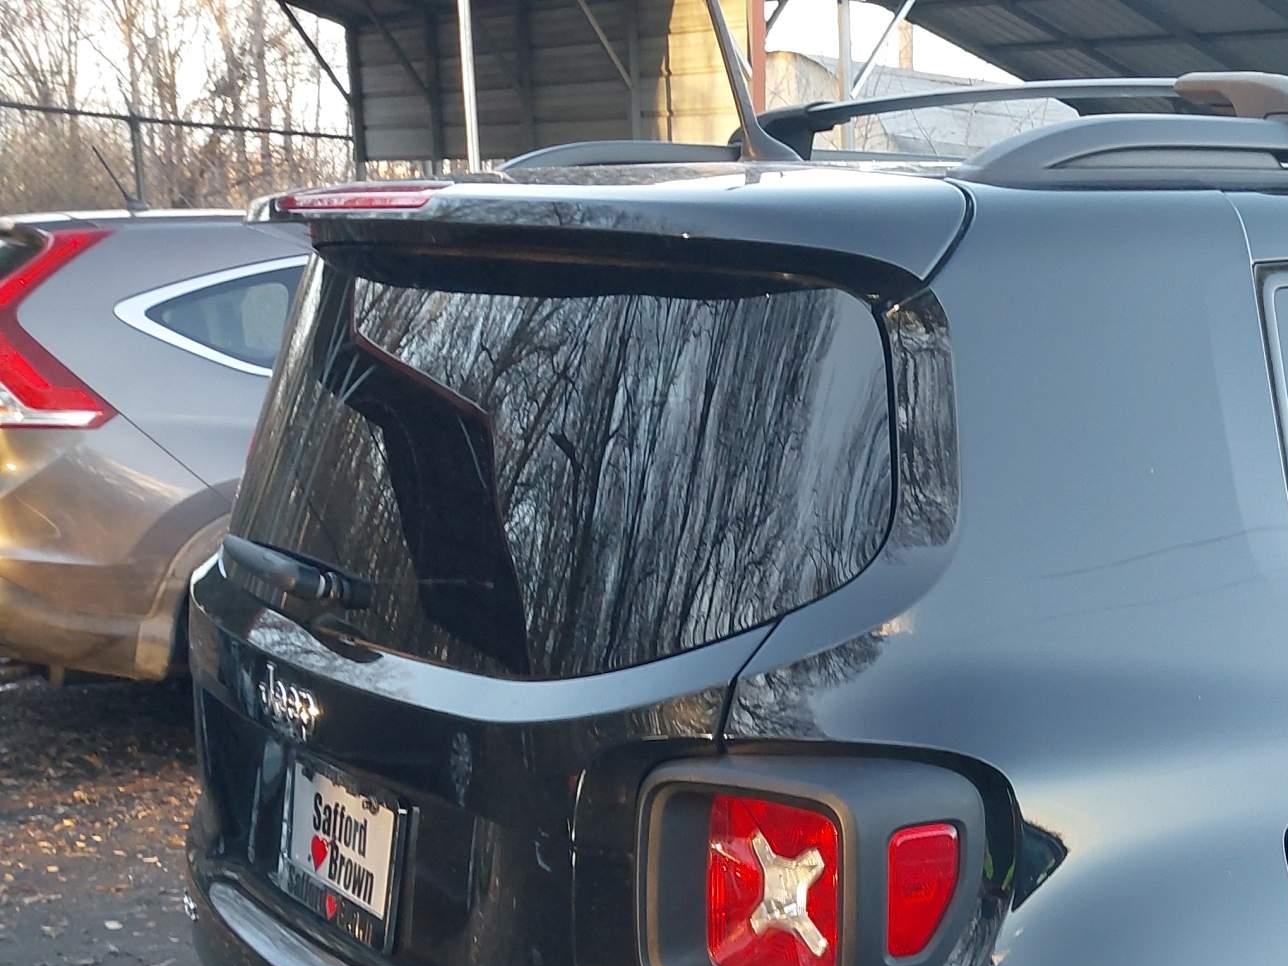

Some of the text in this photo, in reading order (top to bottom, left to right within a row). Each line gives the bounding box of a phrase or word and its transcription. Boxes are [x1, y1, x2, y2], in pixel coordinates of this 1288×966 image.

[259, 663, 319, 741] Jeep
[313, 793, 367, 857] Safford
[328, 842, 374, 905] Brown
